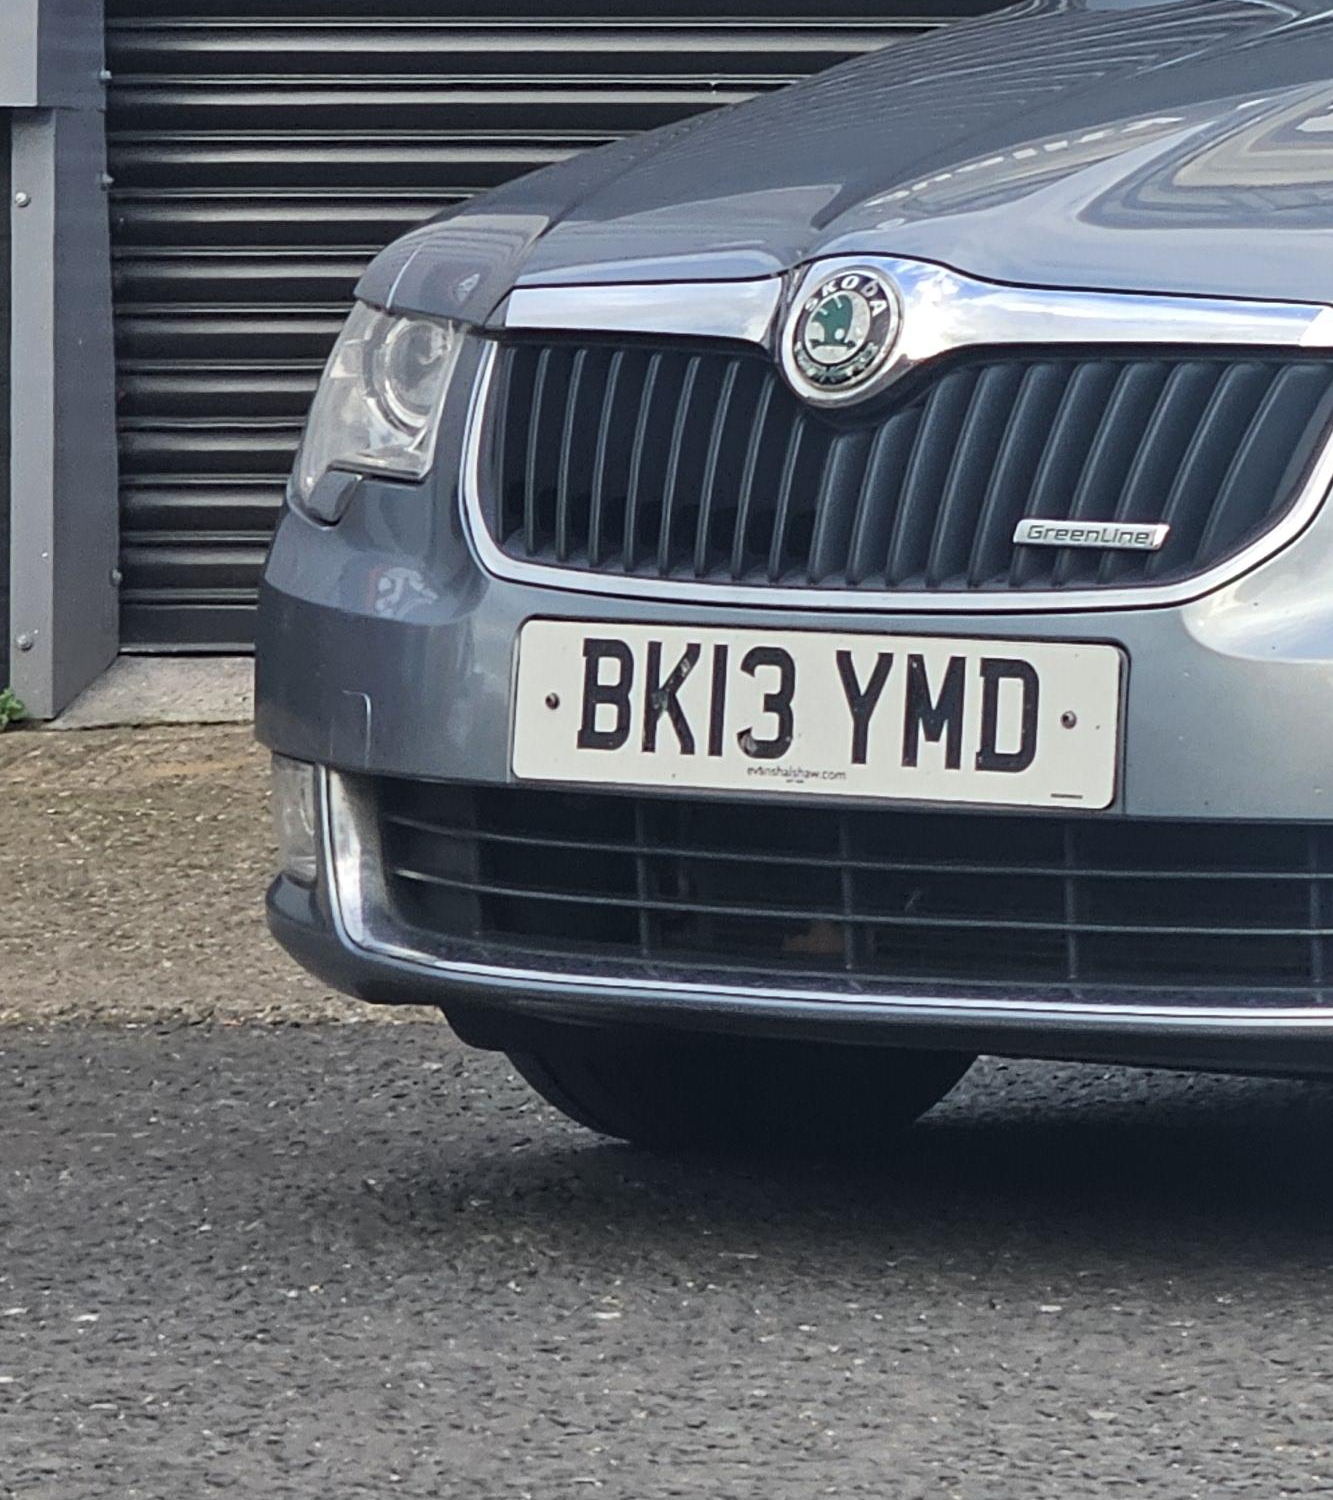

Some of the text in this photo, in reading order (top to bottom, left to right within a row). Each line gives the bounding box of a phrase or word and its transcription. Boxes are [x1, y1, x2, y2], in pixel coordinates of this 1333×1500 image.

[1026, 524, 1149, 544] GreenLine
[576, 637, 1041, 773] BK13 YMD
